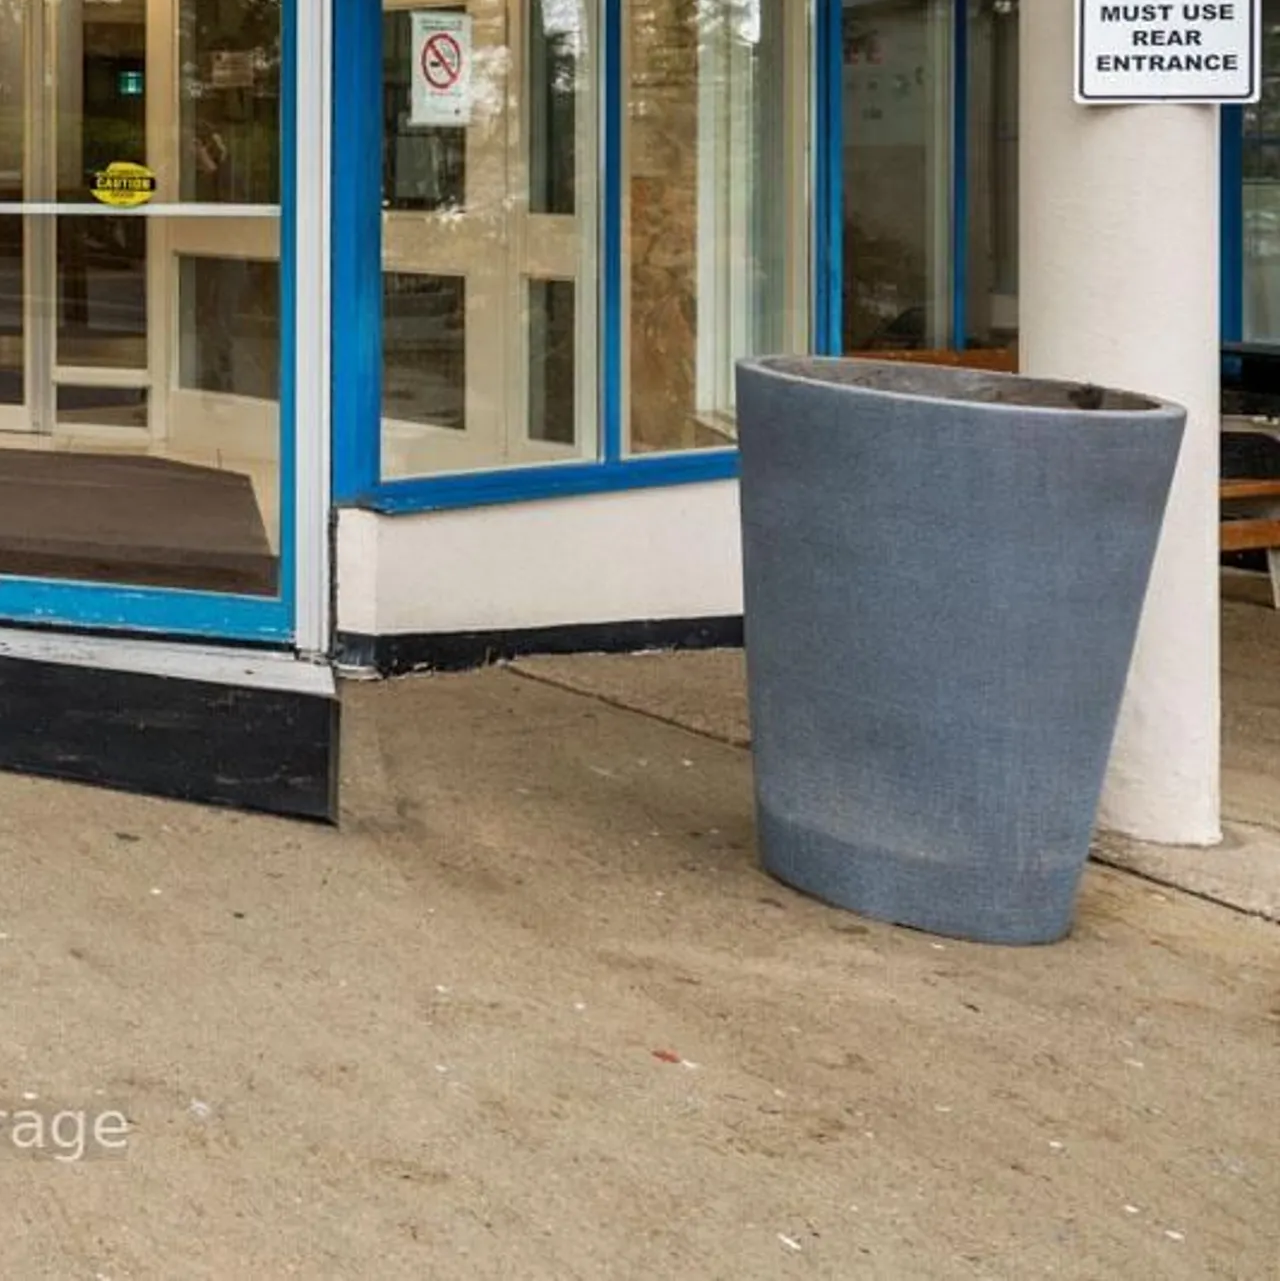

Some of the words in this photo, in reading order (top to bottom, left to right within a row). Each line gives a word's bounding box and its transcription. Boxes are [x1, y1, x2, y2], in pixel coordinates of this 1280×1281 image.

[1100, 4, 1174, 22] MUST
[1183, 3, 1235, 21] USE
[1132, 30, 1203, 46] REAR
[1096, 54, 1239, 72] ENTRANCE
